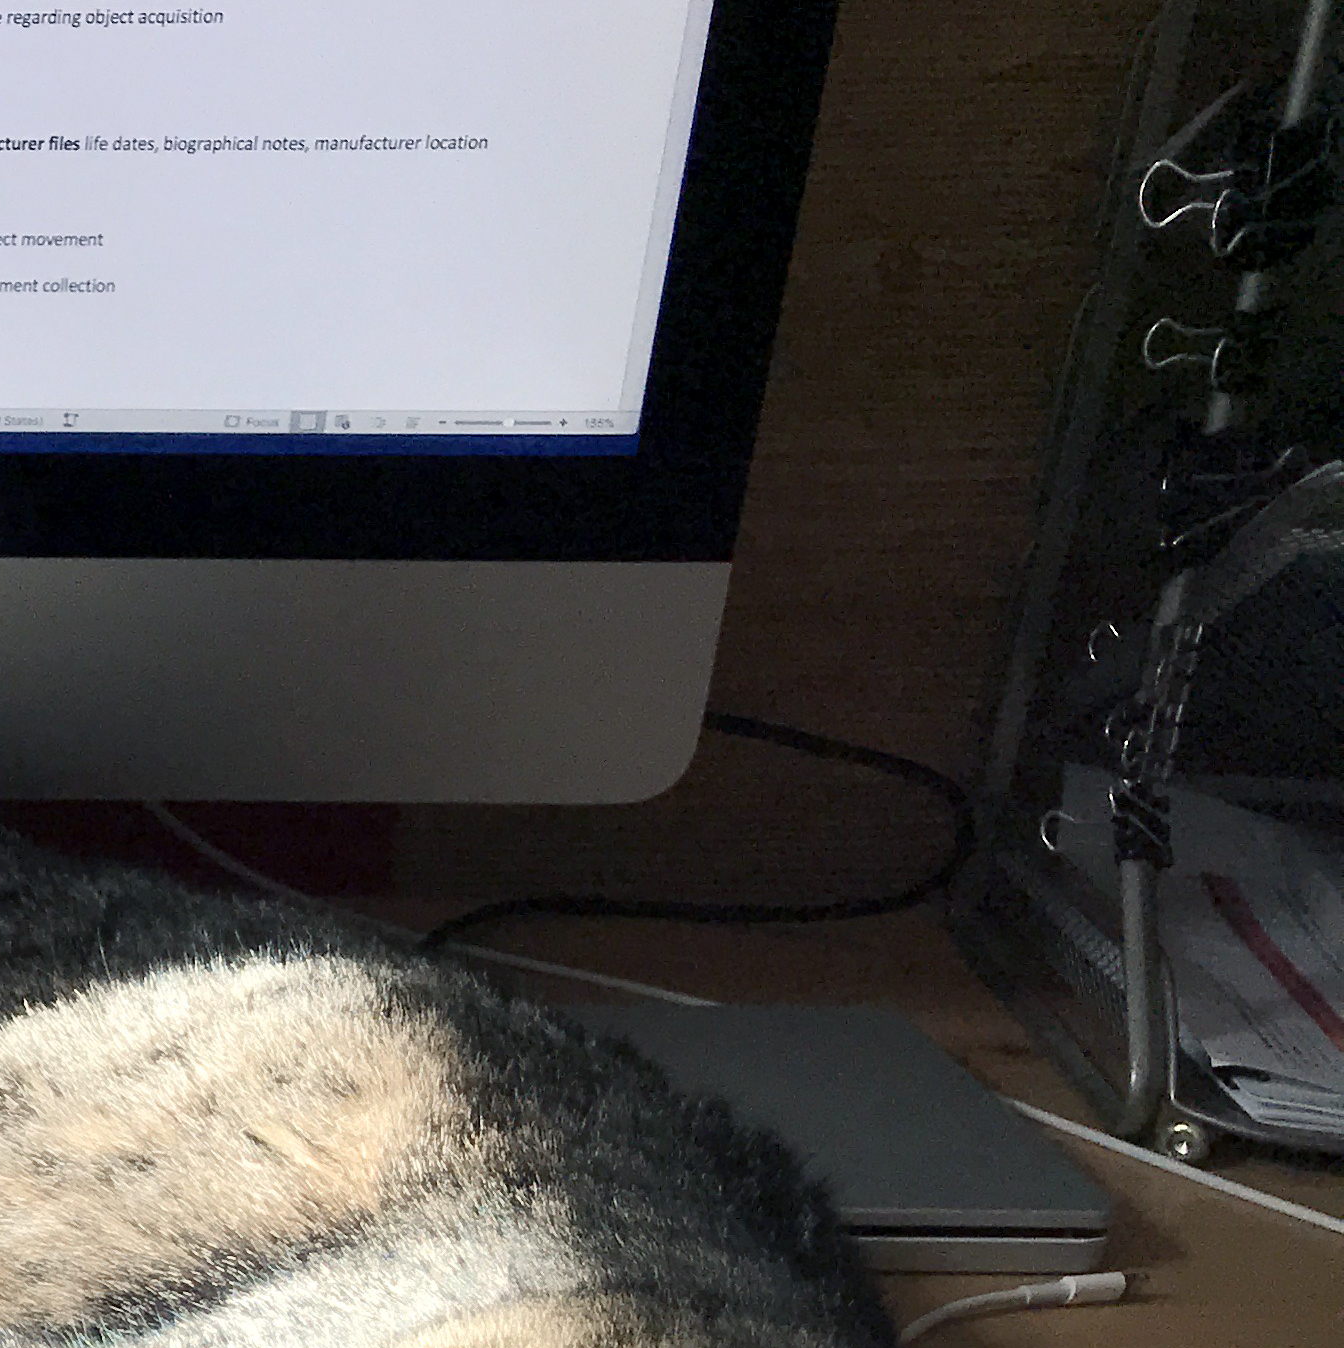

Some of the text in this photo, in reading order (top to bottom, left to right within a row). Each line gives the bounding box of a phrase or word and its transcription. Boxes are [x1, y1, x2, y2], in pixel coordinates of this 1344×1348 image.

[6, 8, 82, 29] regarding
[85, 8, 135, 28] object
[137, 8, 224, 28] acquisition
[48, 135, 81, 152] files
[84, 135, 109, 152] life
[112, 135, 159, 154] dates,
[163, 134, 259, 155] biographical
[261, 135, 310, 154] notes,
[314, 134, 422, 151] manufacturer
[425, 134, 489, 151] location
[20, 230, 104, 247] movement
[42, 276, 116, 293] collection
